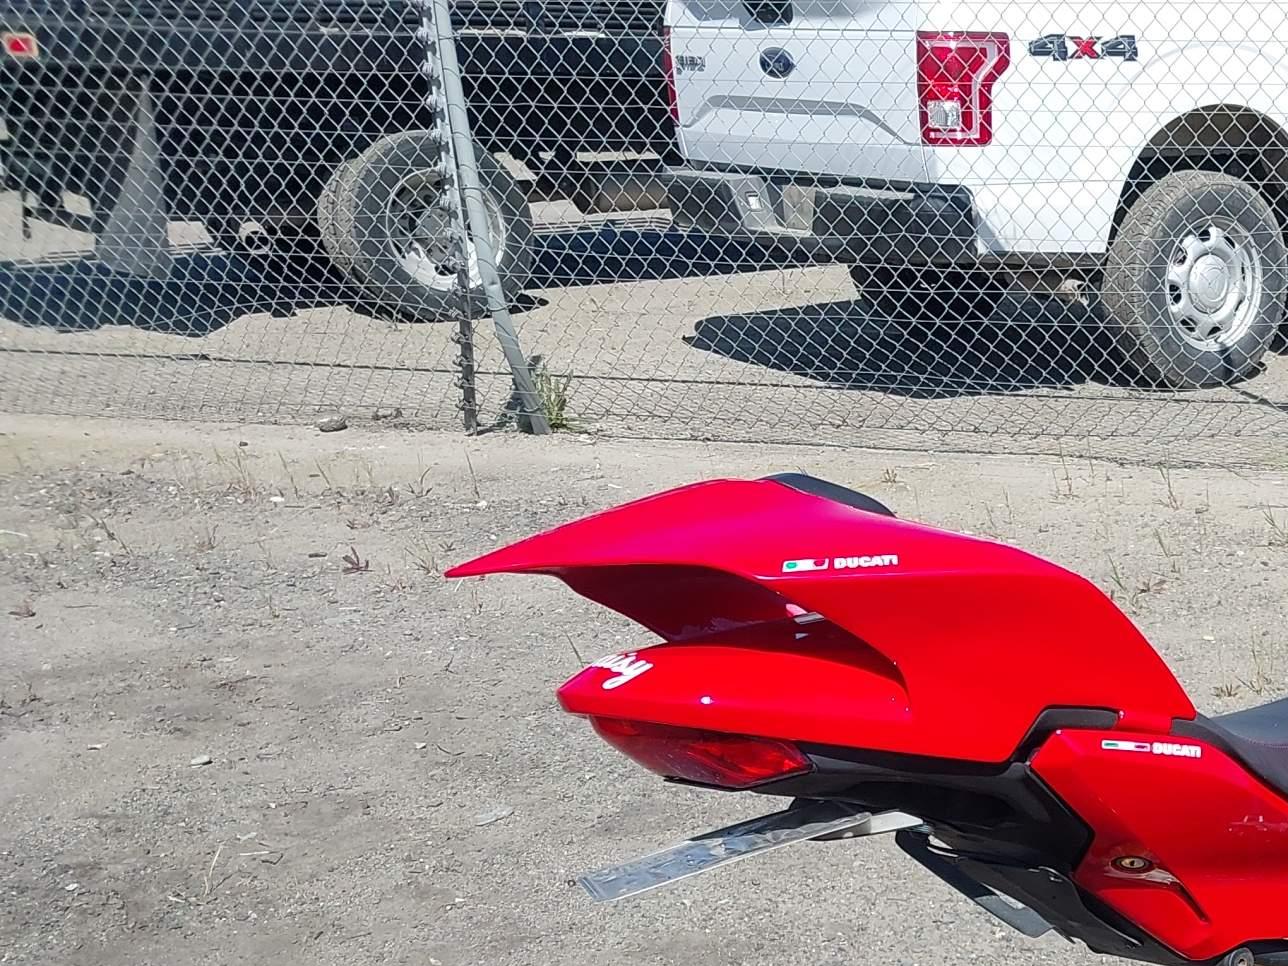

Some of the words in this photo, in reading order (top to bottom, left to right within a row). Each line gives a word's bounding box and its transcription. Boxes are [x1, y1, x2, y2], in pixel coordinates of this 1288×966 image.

[1028, 33, 1139, 61] 4x4
[833, 554, 898, 570] DUCATI
[1152, 742, 1202, 758] DUCATI
